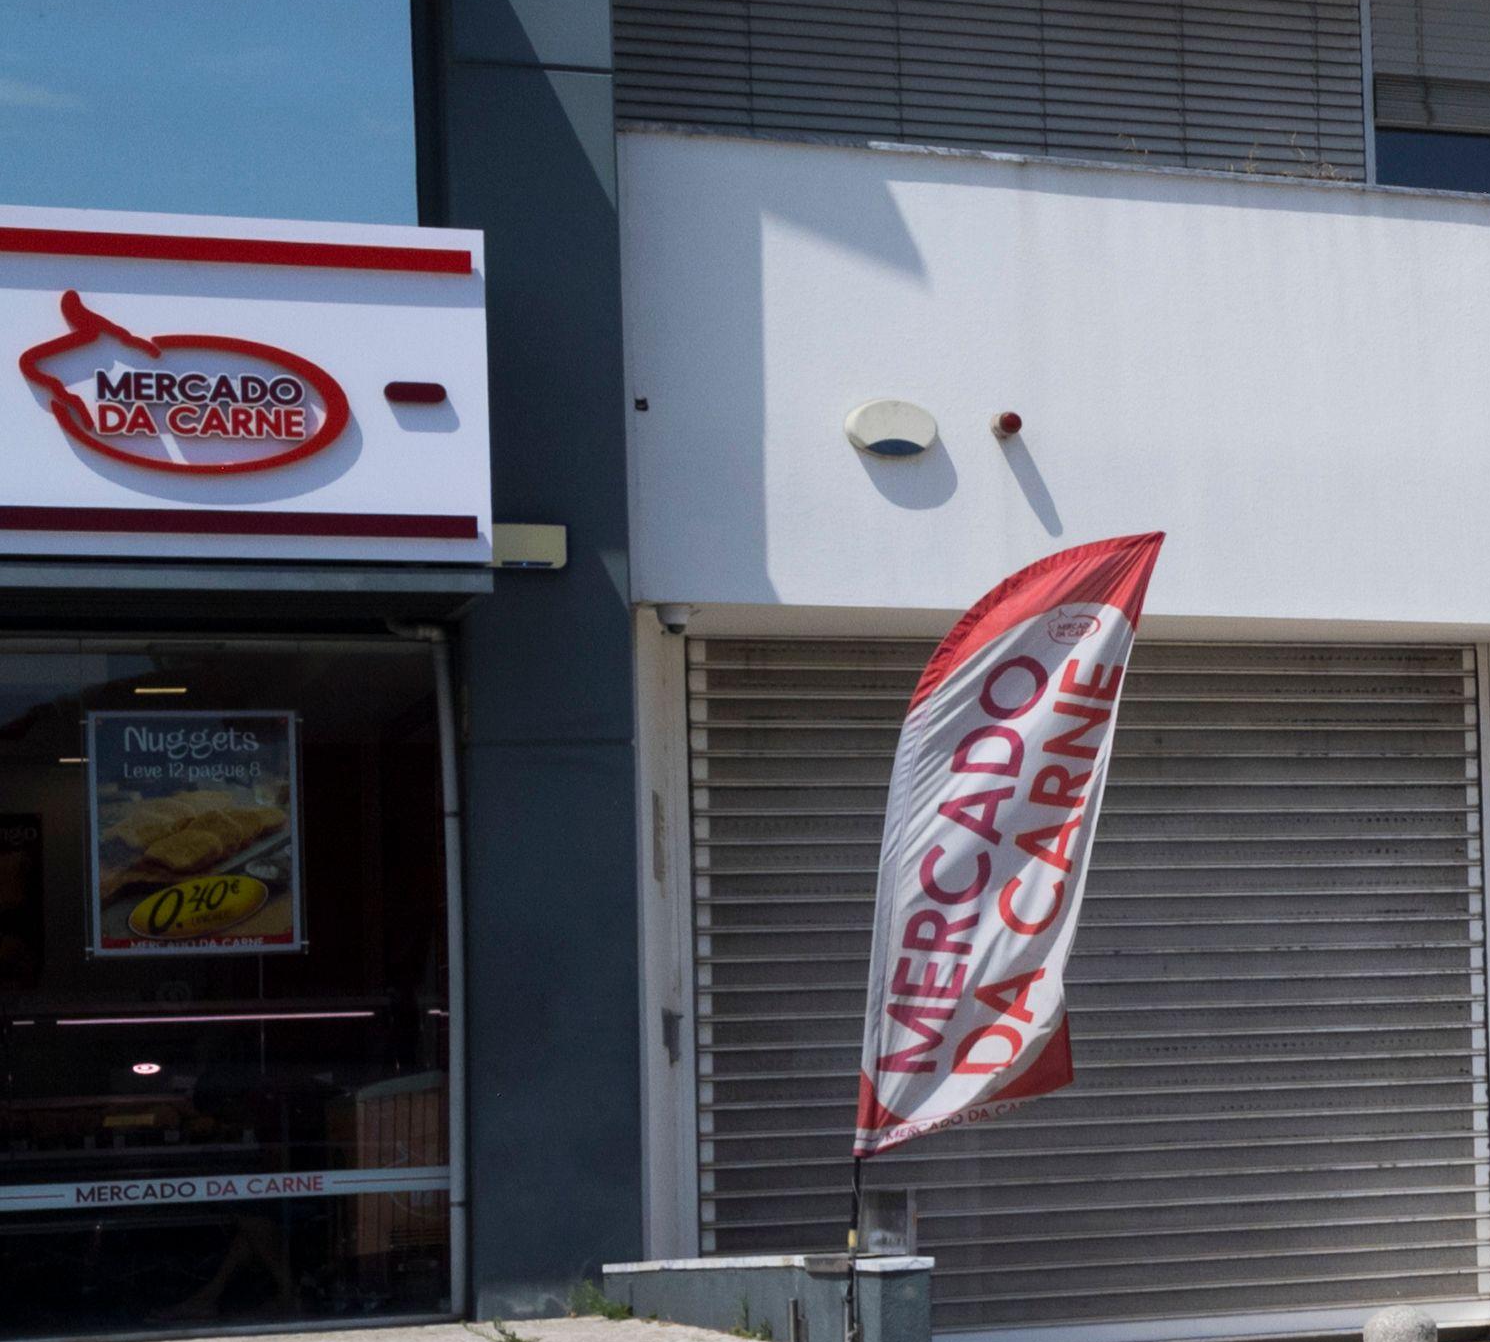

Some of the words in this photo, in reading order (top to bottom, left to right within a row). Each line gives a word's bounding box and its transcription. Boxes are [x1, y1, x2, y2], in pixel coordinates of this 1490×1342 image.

[95, 369, 304, 406] MERCADO
[97, 403, 158, 435] DA
[167, 405, 305, 438] CARNE
[123, 726, 260, 759] Nuggets
[123, 762, 163, 778] Leve
[168, 762, 185, 777] 12
[188, 765, 245, 782] pague
[249, 761, 262, 777] 8
[877, 655, 1048, 1074] MERCADO
[950, 967, 1045, 1075] DA
[998, 658, 1124, 936] CARNE
[75, 1180, 197, 1204] MERCADO
[206, 1178, 238, 1198] DA
[247, 1174, 324, 1196] CARNE
